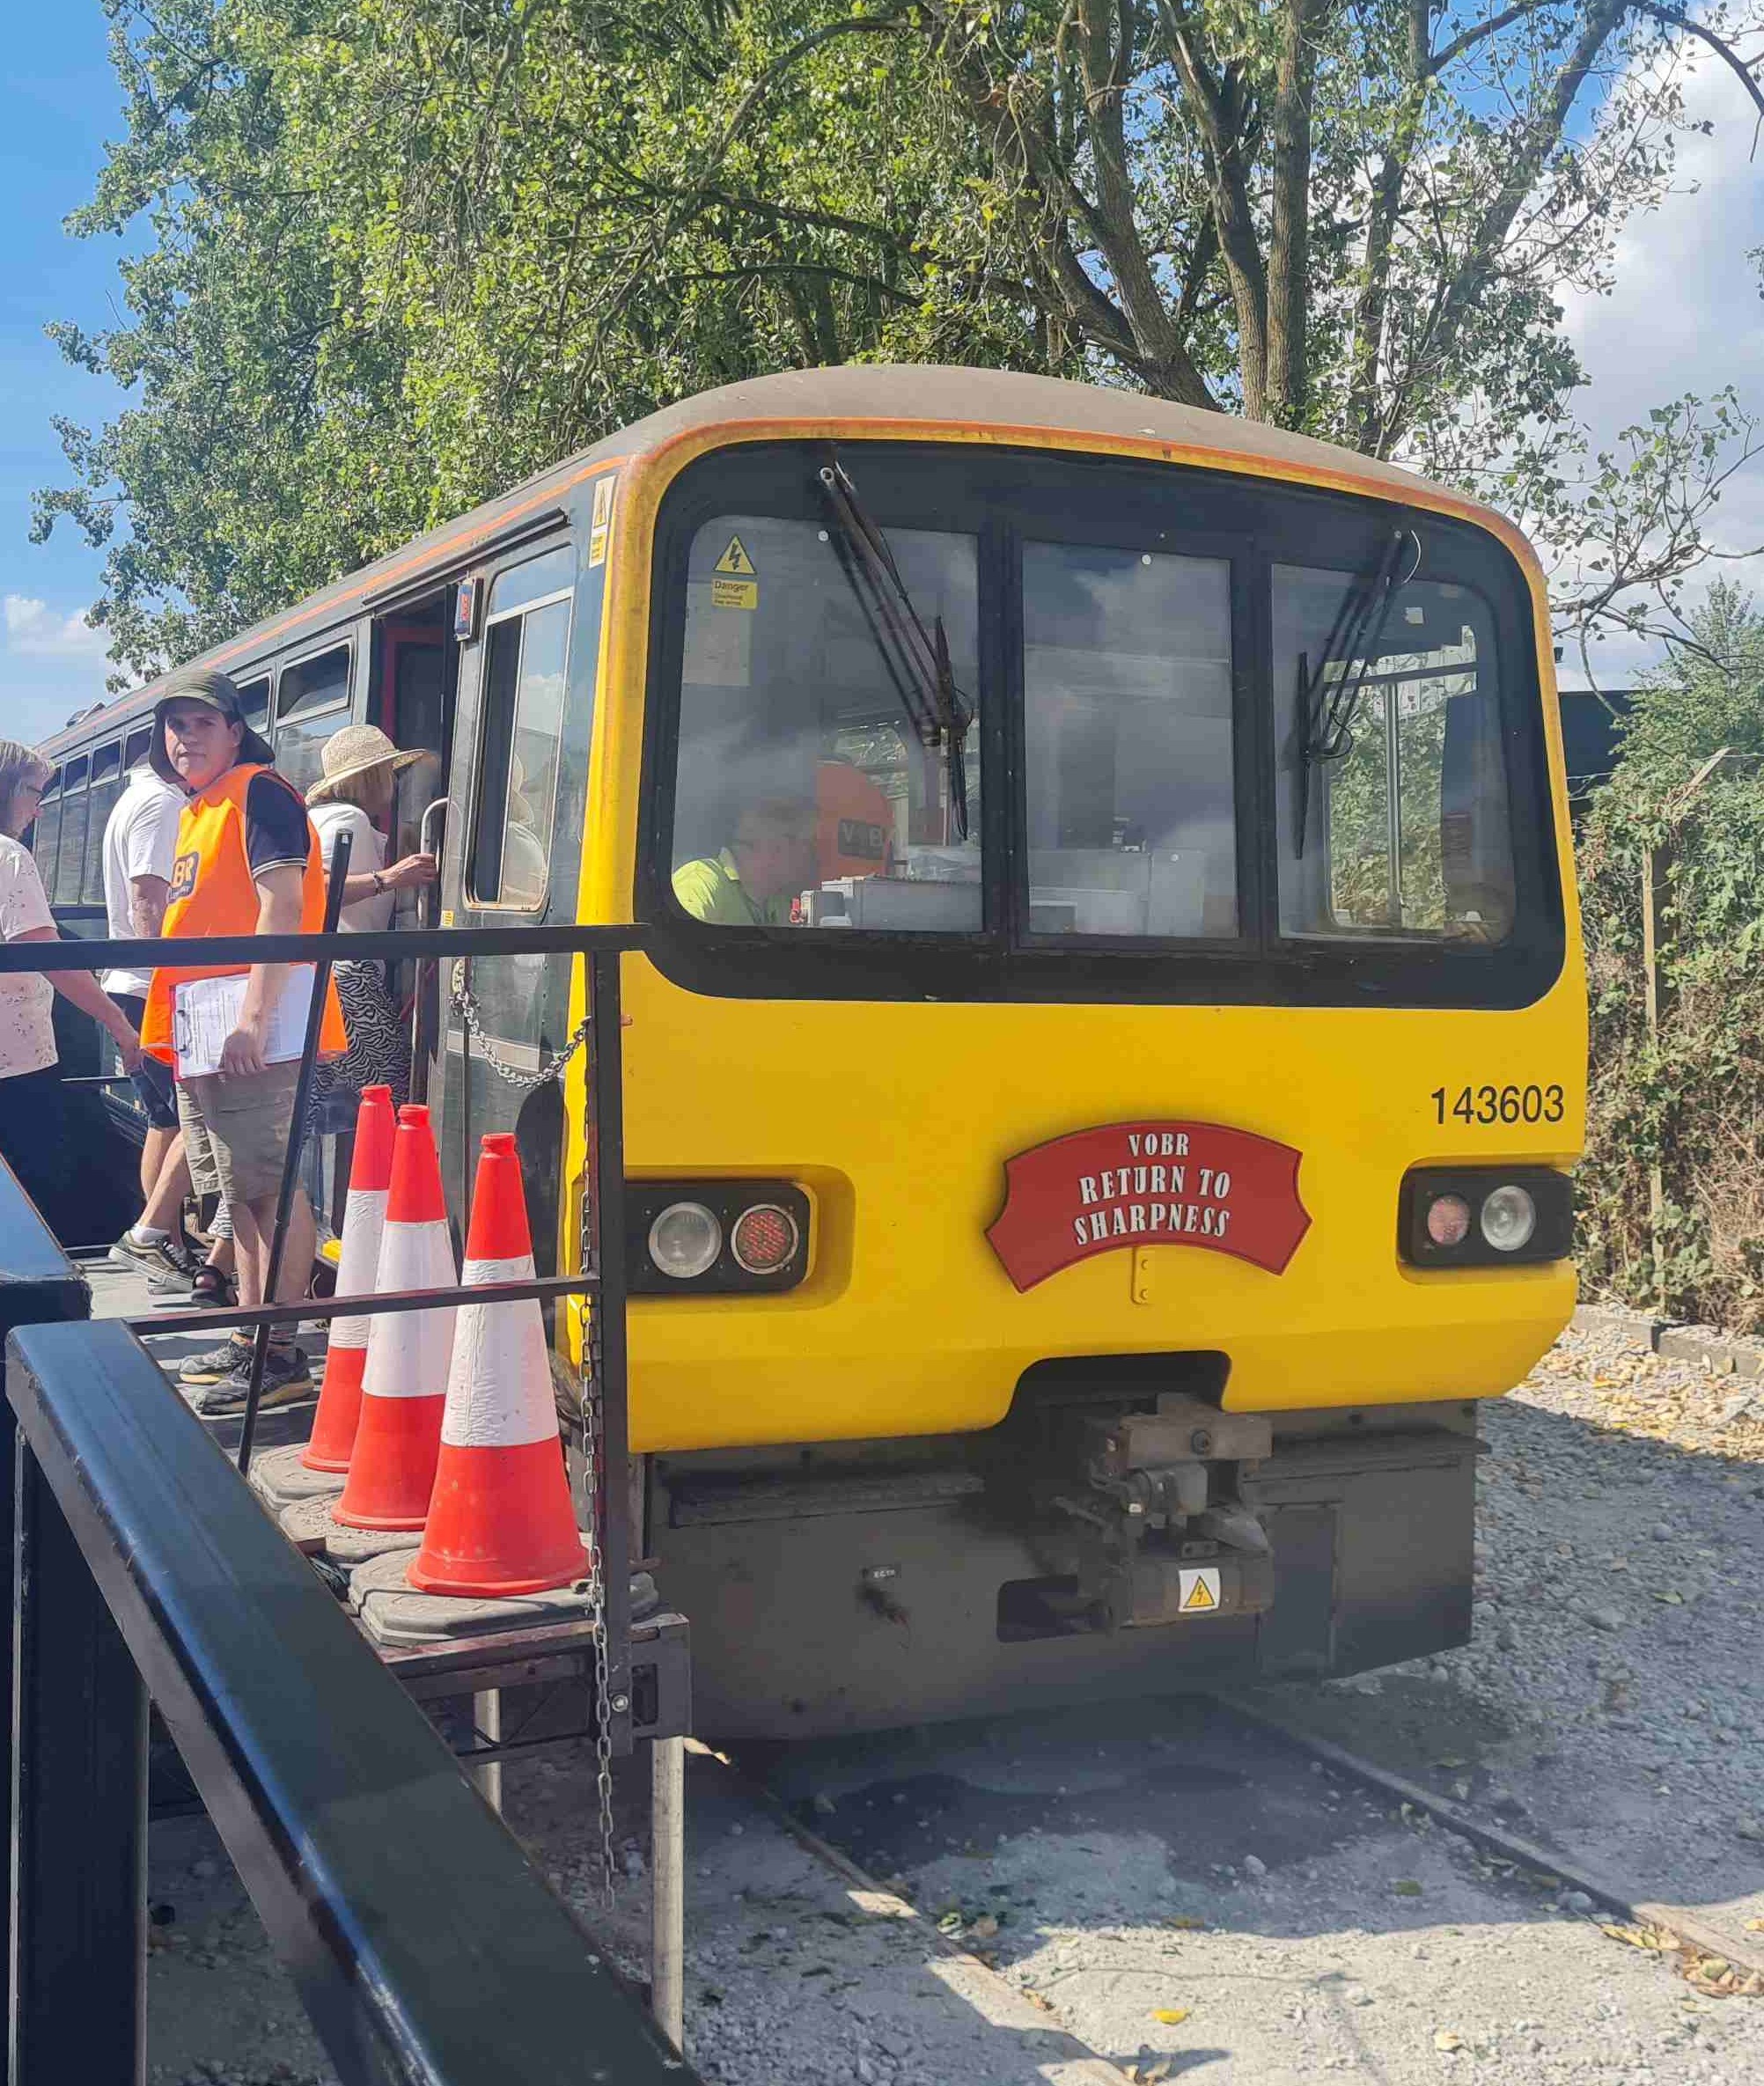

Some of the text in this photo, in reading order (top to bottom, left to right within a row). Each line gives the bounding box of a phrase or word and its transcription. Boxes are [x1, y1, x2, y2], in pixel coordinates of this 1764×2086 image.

[714, 580, 749, 593] Danger
[1431, 1084, 1564, 1124] 143603
[1128, 1133, 1189, 1157] VOBR
[1079, 1165, 1231, 1205] RETURN TO
[1072, 1203, 1231, 1245] SHARPNESS
